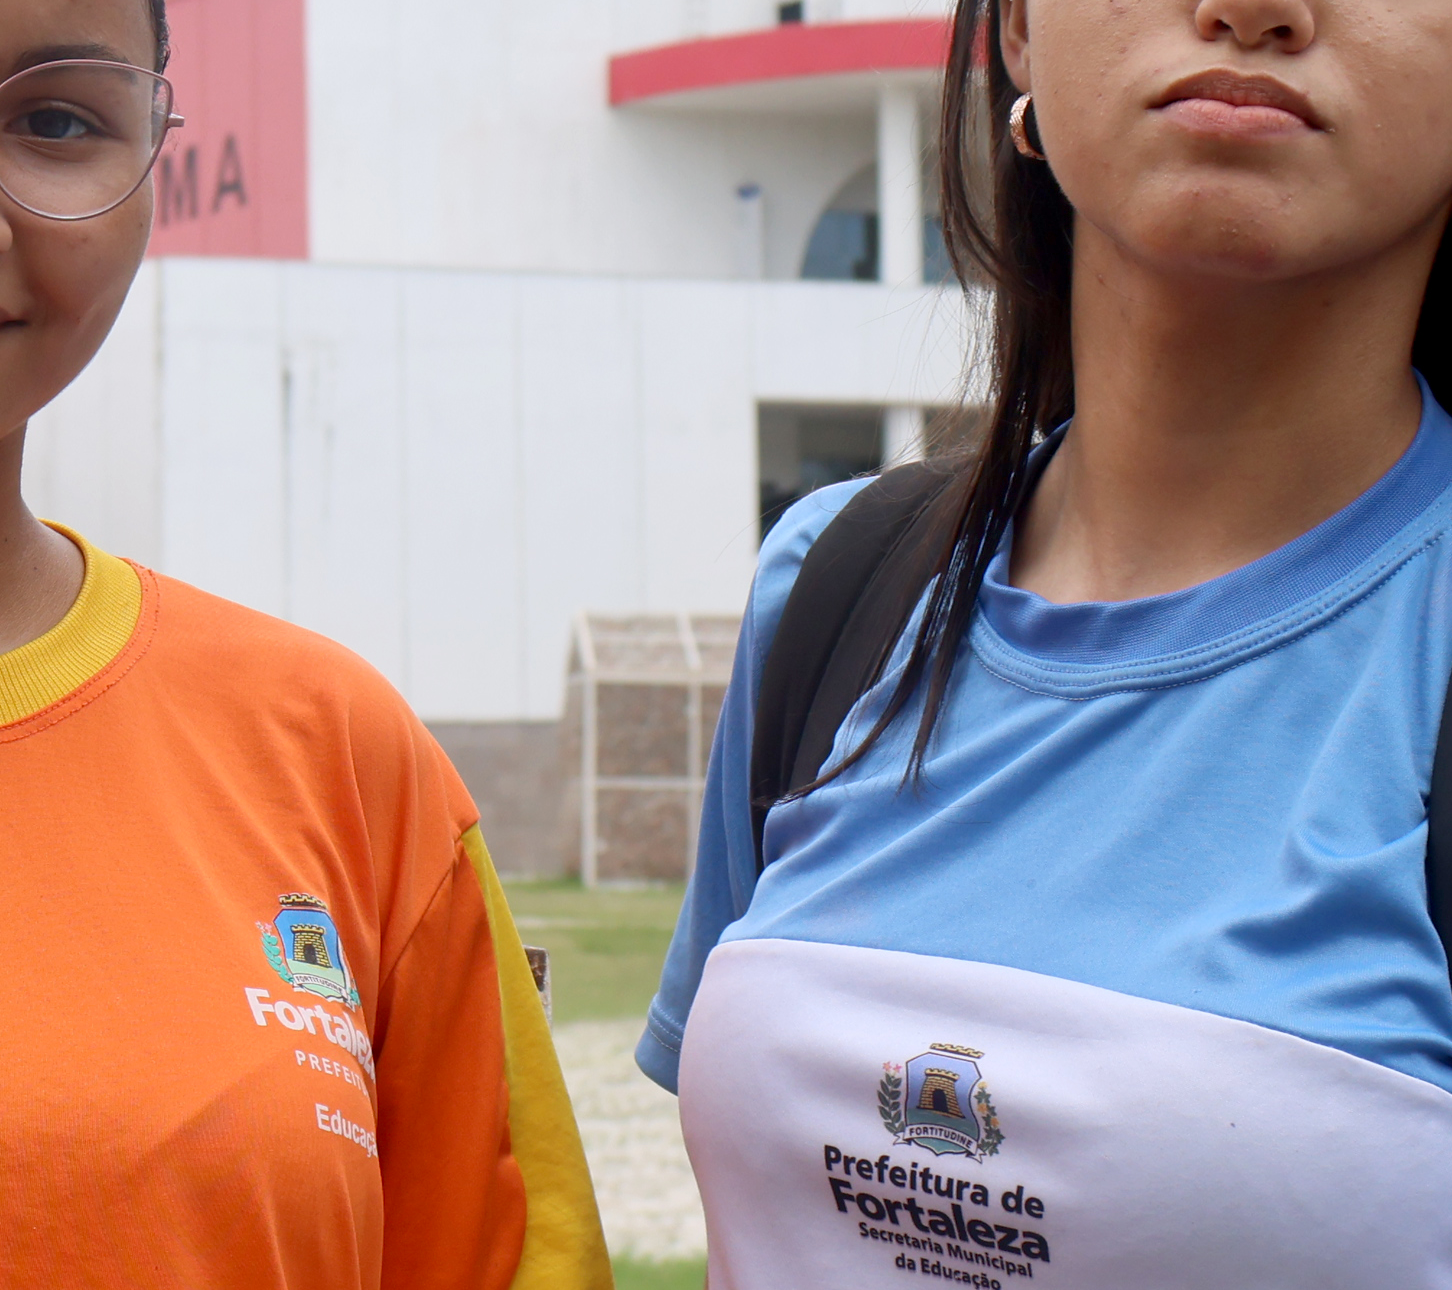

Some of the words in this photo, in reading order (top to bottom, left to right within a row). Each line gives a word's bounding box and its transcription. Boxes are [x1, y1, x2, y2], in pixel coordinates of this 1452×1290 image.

[908, 1125, 973, 1149] FORTITUDINE
[824, 1144, 990, 1207] Prefeitura
[1001, 1185, 1045, 1219] de
[828, 1176, 1051, 1263] Fortaleza
[858, 1221, 944, 1255] Secretaria
[946, 1243, 1033, 1278] Municipal
[895, 1253, 917, 1272] da
